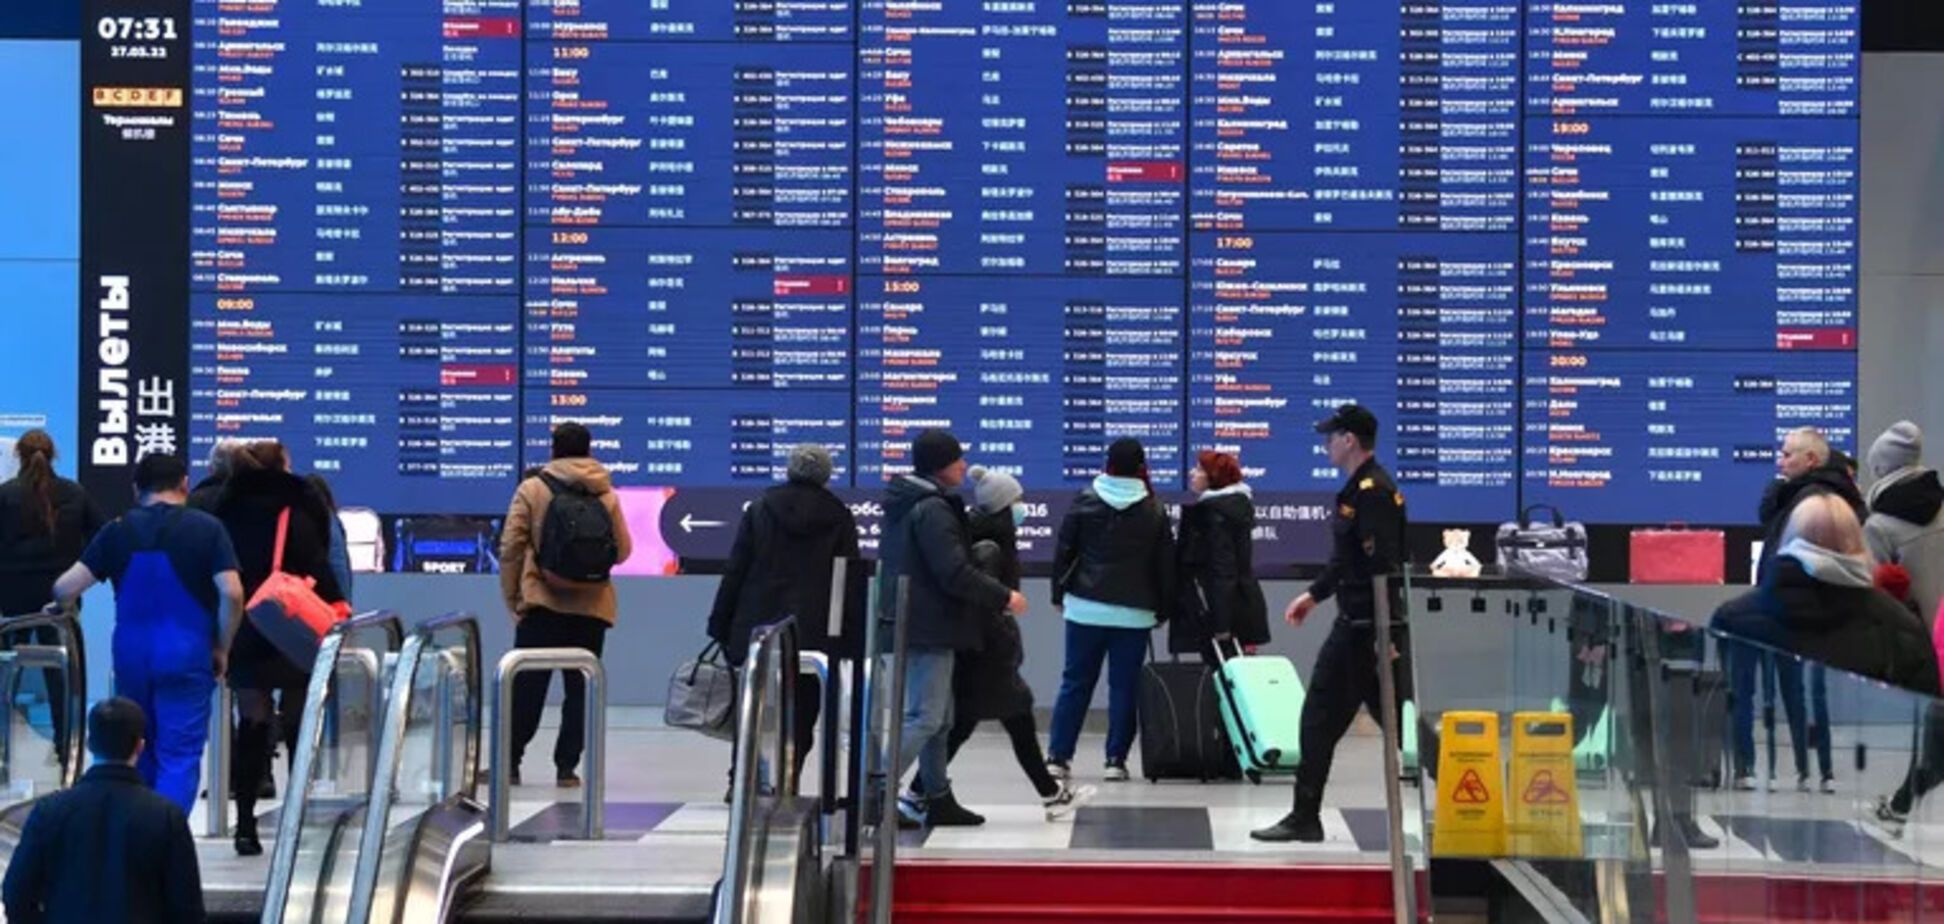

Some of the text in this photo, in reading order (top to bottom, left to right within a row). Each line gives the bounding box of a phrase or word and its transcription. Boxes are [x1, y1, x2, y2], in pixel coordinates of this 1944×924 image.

[1216, 3, 1244, 12] Сочи
[98, 16, 178, 39] 07:31
[1218, 26, 1244, 35] Сочи
[554, 48, 589, 57] 11:00
[884, 48, 911, 56] Сочи
[885, 94, 906, 106] Уфа
[1553, 123, 1588, 133] 19:00
[218, 134, 245, 143] Сочи
[1550, 167, 1578, 175] Сочи
[1215, 212, 1243, 220] Сочи
[553, 233, 588, 243] 12:00
[1217, 237, 1252, 248] 17:00
[216, 251, 244, 259] Сочи
[885, 282, 919, 292] 15:00
[217, 299, 253, 309] 09:00
[550, 299, 577, 309] Сочи
[1551, 356, 1587, 366] 20:00
[92, 275, 130, 466] Вылеты
[1215, 374, 1239, 386] Уфа
[552, 395, 587, 405] 13:00
[134, 376, 176, 465] 出港
[422, 562, 466, 573] SPORT
